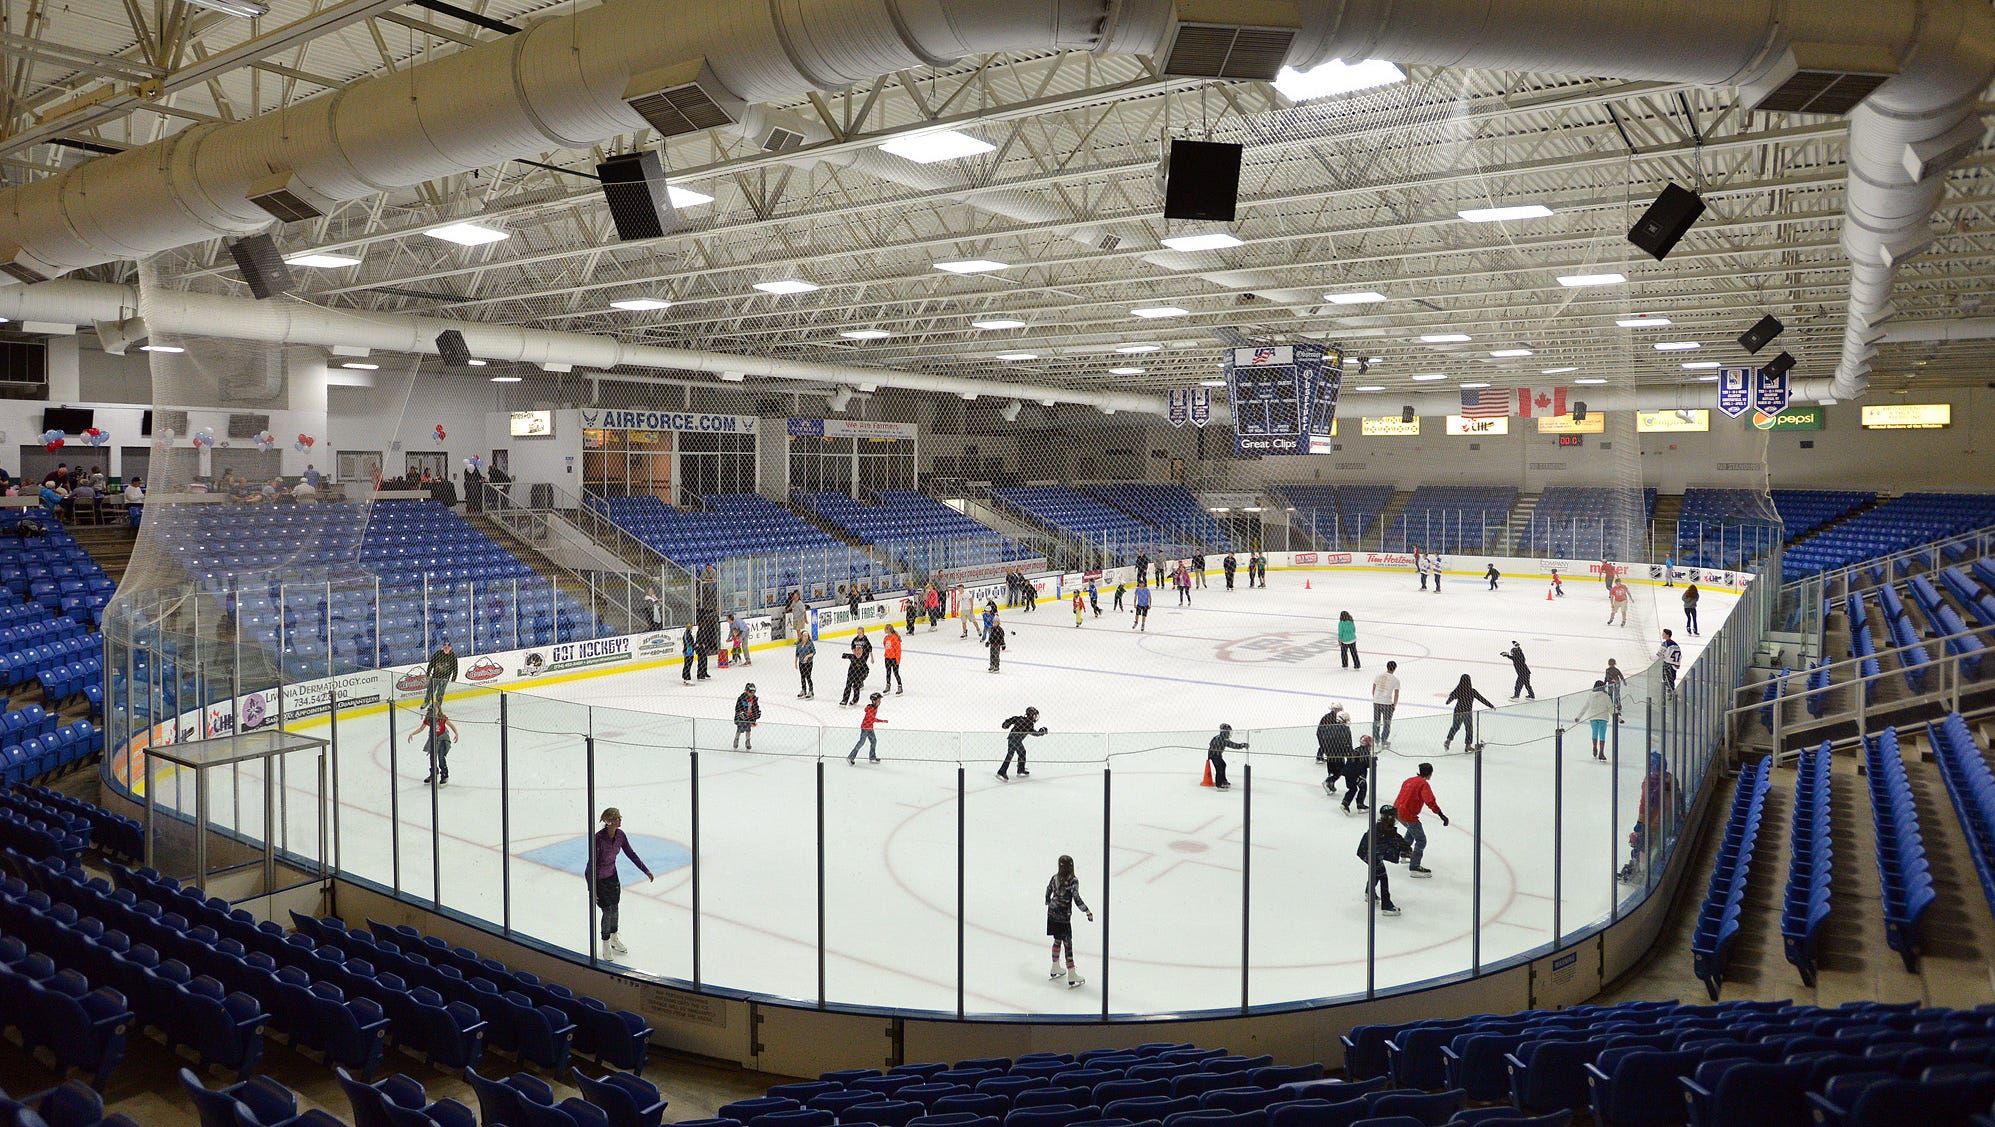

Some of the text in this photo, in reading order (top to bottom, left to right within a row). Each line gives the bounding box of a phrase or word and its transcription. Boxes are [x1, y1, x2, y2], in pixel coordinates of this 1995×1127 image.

[1255, 348, 1276, 359] USA
[603, 411, 736, 432] AIRFORCE.COM
[1778, 414, 1814, 425] pepsi
[1241, 439, 1296, 450] Great Clips
[1367, 554, 1414, 564] Tim Hortons
[553, 642, 576, 662] GOT
[579, 638, 629, 658] HOCKEY?
[266, 688, 297, 703] LIVNIA
